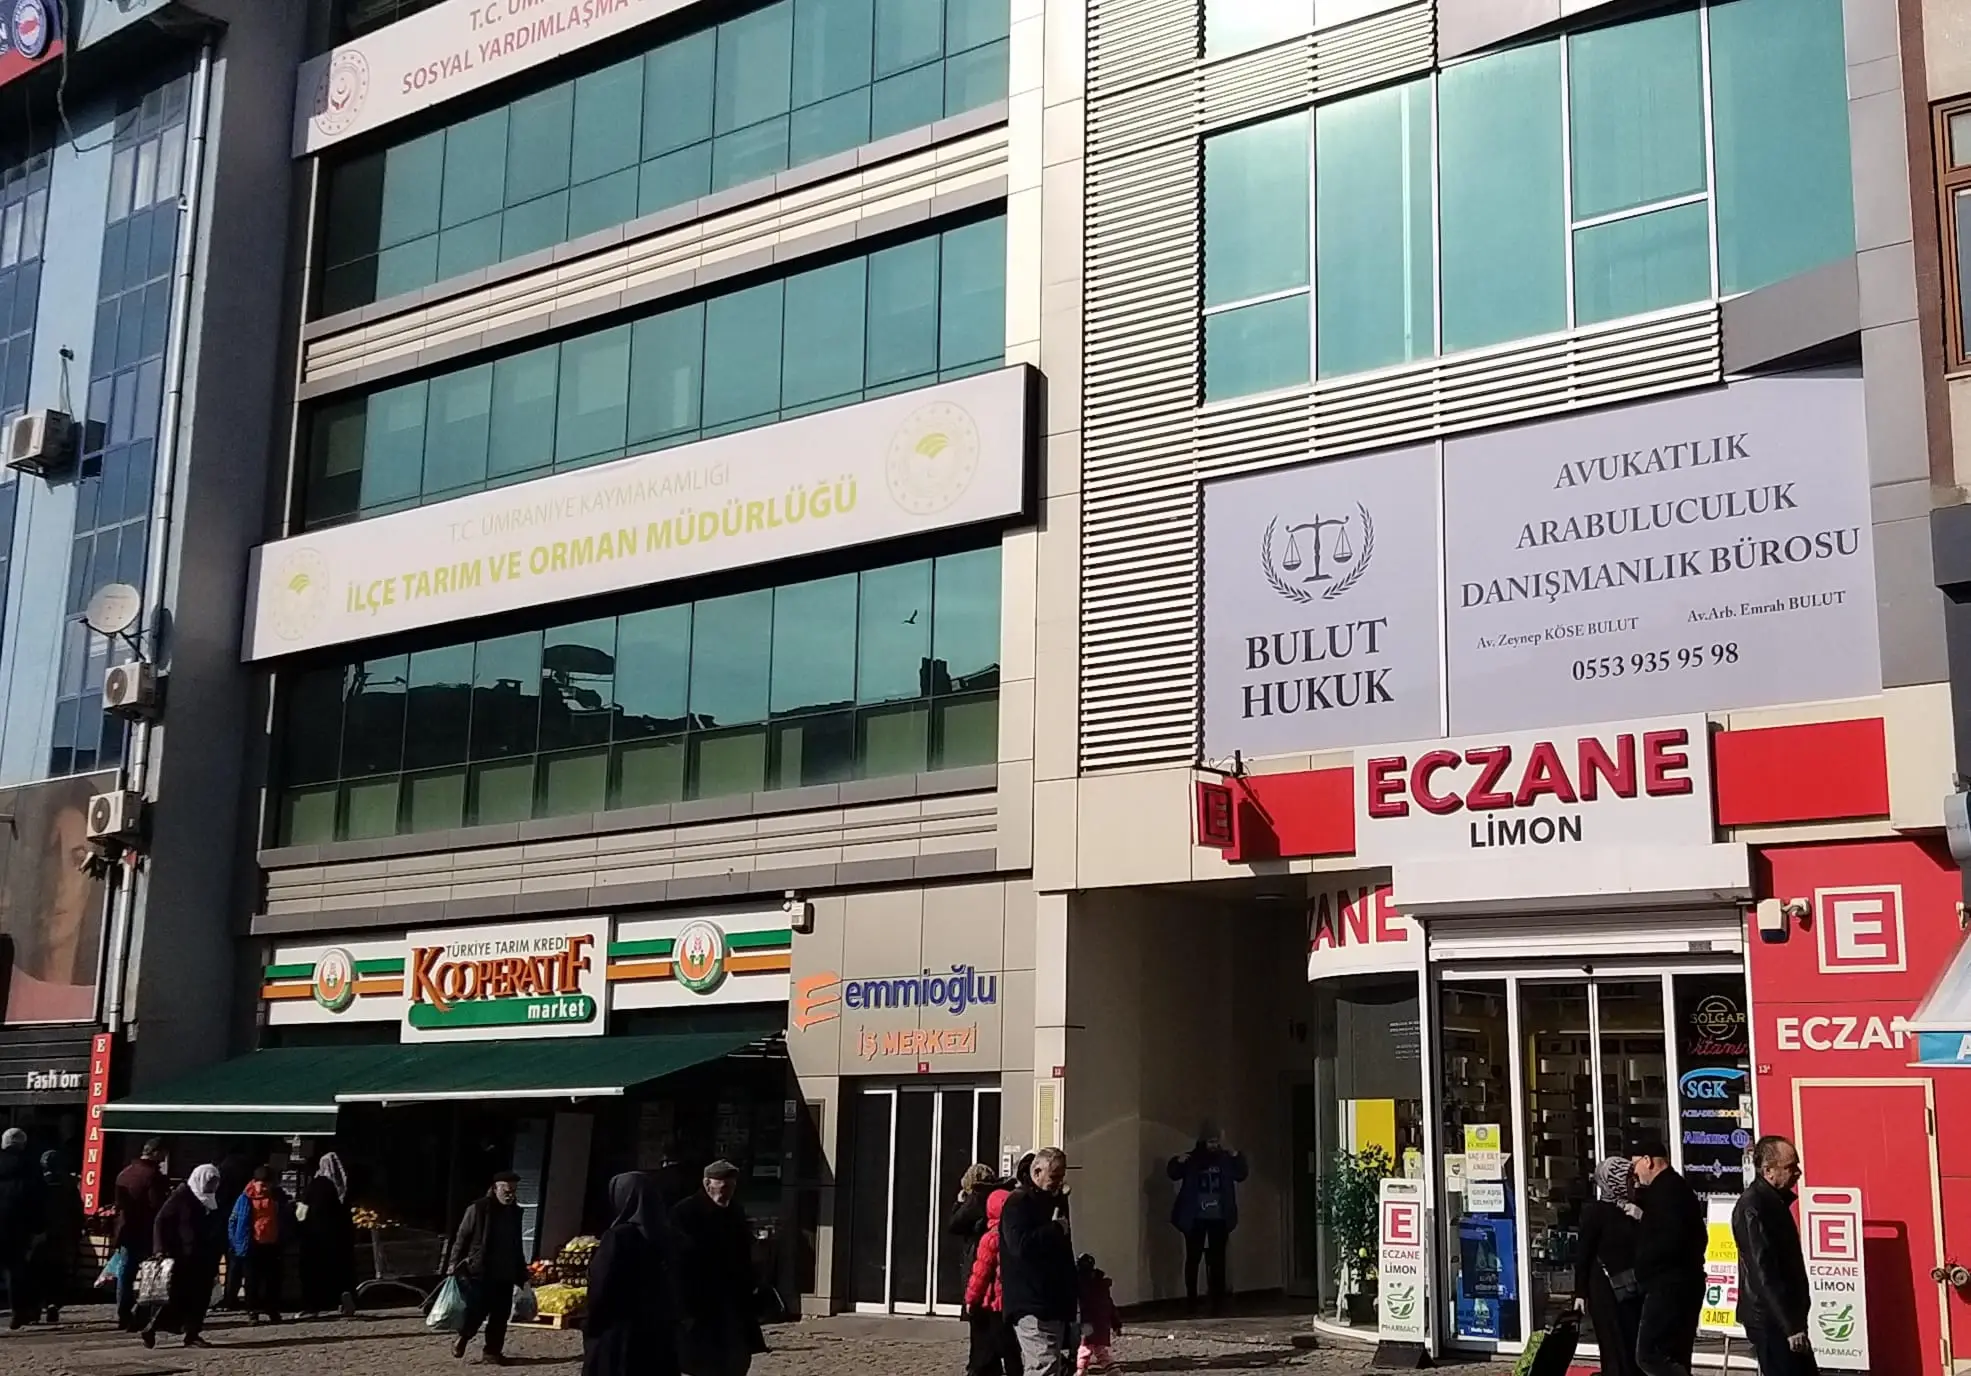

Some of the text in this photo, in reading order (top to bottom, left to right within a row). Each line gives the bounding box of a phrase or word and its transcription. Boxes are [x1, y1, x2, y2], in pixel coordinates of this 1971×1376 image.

[402, 0, 629, 95] SOSYAL YARDIMLAŞMA
[1554, 432, 1751, 489] AVUKATLIK
[1515, 482, 1799, 549] ARABULUCULUK
[346, 473, 857, 615] İLÇE TARIM VE ORMAN MÜDÜRLÜĞÜ
[1461, 527, 1861, 609] DANIŞMANLIK BÜROSU
[1740, 600, 1785, 617] Emrah
[1788, 590, 1846, 611] BULUT
[1245, 616, 1388, 671] BULUT
[1498, 631, 1542, 649] Zeynep
[1545, 623, 1584, 642] KÖSE
[1587, 617, 1639, 636] BULUT
[1572, 641, 1740, 681] 0553 935 95 98
[1241, 667, 1395, 719] HUKUK
[1367, 728, 1694, 818] ECZANE
[1469, 813, 1583, 848] LİMON
[1307, 884, 1408, 953] ANE
[1833, 899, 1887, 959] E
[446, 932, 568, 958] TÜRKİYE TARIM KREDİ
[845, 963, 997, 1016] emmioğlu
[527, 998, 586, 1019] market
[1689, 1013, 1746, 1024] SOLGAR
[858, 1021, 978, 1061] İŞ MERKEZİ
[1686, 1080, 1728, 1099] SGK
[85, 1037, 106, 1209] ELEGANCE
[1391, 1209, 1413, 1238] E
[1819, 1220, 1847, 1254] E
[1382, 1249, 1420, 1260] ECZANE
[1385, 1262, 1417, 1275] LİMON
[1810, 1265, 1859, 1277] ECZANE
[1814, 1278, 1855, 1292] LİMON
[1381, 1323, 1420, 1333] PHARMACY
[1712, 1311, 1730, 1324] ADET
[1813, 1347, 1863, 1357] PHARMACY
